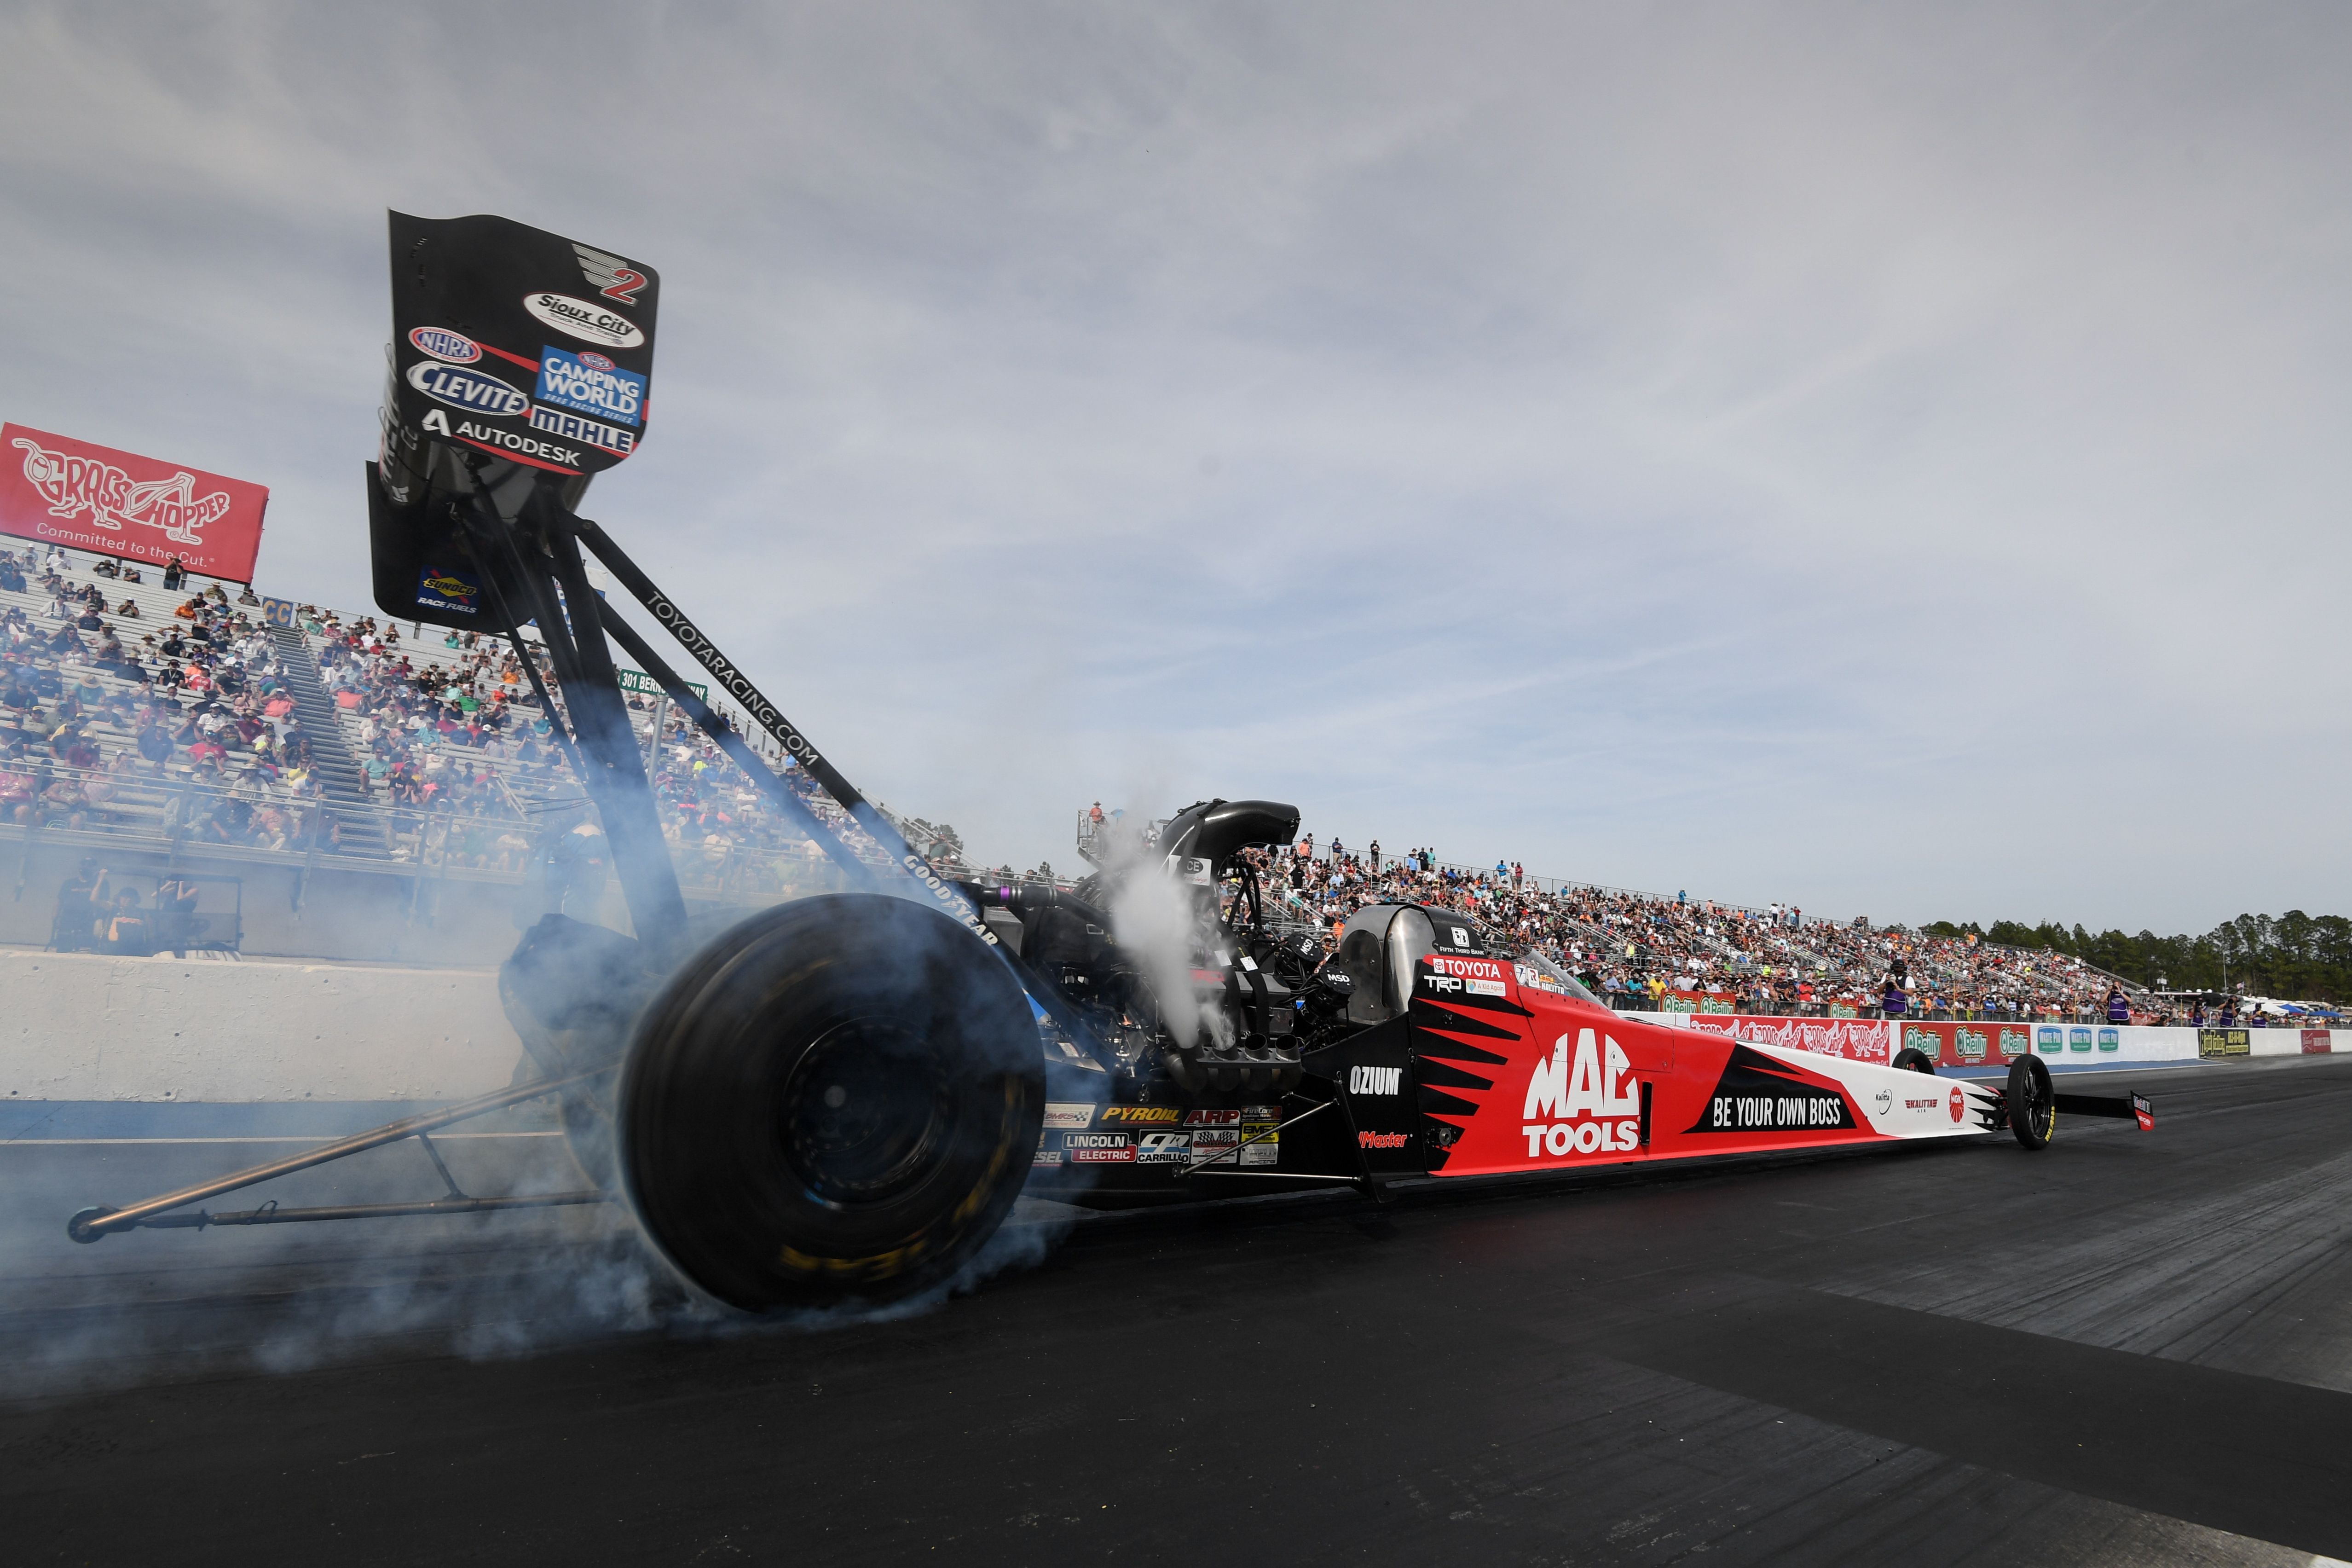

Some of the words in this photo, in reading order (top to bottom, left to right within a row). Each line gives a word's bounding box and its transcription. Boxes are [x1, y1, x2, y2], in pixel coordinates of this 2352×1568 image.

[600, 266, 648, 307] 2
[538, 295, 594, 321] Sioux
[598, 315, 636, 336] City
[421, 333, 471, 357] NHRA
[583, 354, 612, 369] NHRA
[410, 361, 527, 413] CLEVITE
[544, 358, 639, 398] CAMPING
[544, 371, 637, 414] WORLD
[603, 411, 633, 423] SERIES
[532, 407, 632, 453] MAHLE
[456, 421, 581, 467] AUTODESK
[37, 523, 126, 550] Committed
[131, 542, 145, 555] to
[150, 546, 174, 560] the
[426, 579, 476, 595] SUNOCO
[417, 597, 447, 608] RACE
[445, 603, 477, 613] FUELS
[622, 672, 638, 689] 301
[647, 591, 820, 766] TOYOTARACING.COM
[903, 855, 998, 946] GOODYEAR
[1300, 938, 1314, 955] MSD
[1327, 974, 1350, 982] MSD
[1445, 959, 1501, 978] TOYOTA
[1423, 975, 1462, 993] TRD
[1541, 982, 1564, 995] KALITTA
[1906, 1029, 1941, 1055] O'Reilly
[1955, 1030, 1987, 1056] O'Reilly
[2001, 1030, 2028, 1054] O'Reilly
[1350, 1065, 1400, 1095] OZIUM
[1523, 1028, 1639, 1119] MAC
[1910, 1099, 1933, 1109] KALITTA
[1951, 1095, 1961, 1104] NGK
[1185, 1110, 1239, 1123] ARP
[1713, 1097, 1732, 1127] BE
[1736, 1097, 1773, 1126] YOUR
[1777, 1097, 1806, 1126] OWN
[1809, 1098, 1840, 1125] BOSS
[1066, 1136, 1125, 1148] LINCOLN
[1522, 1121, 1638, 1157] TOOLS
[1079, 1151, 1131, 1160] ELECTRIC
